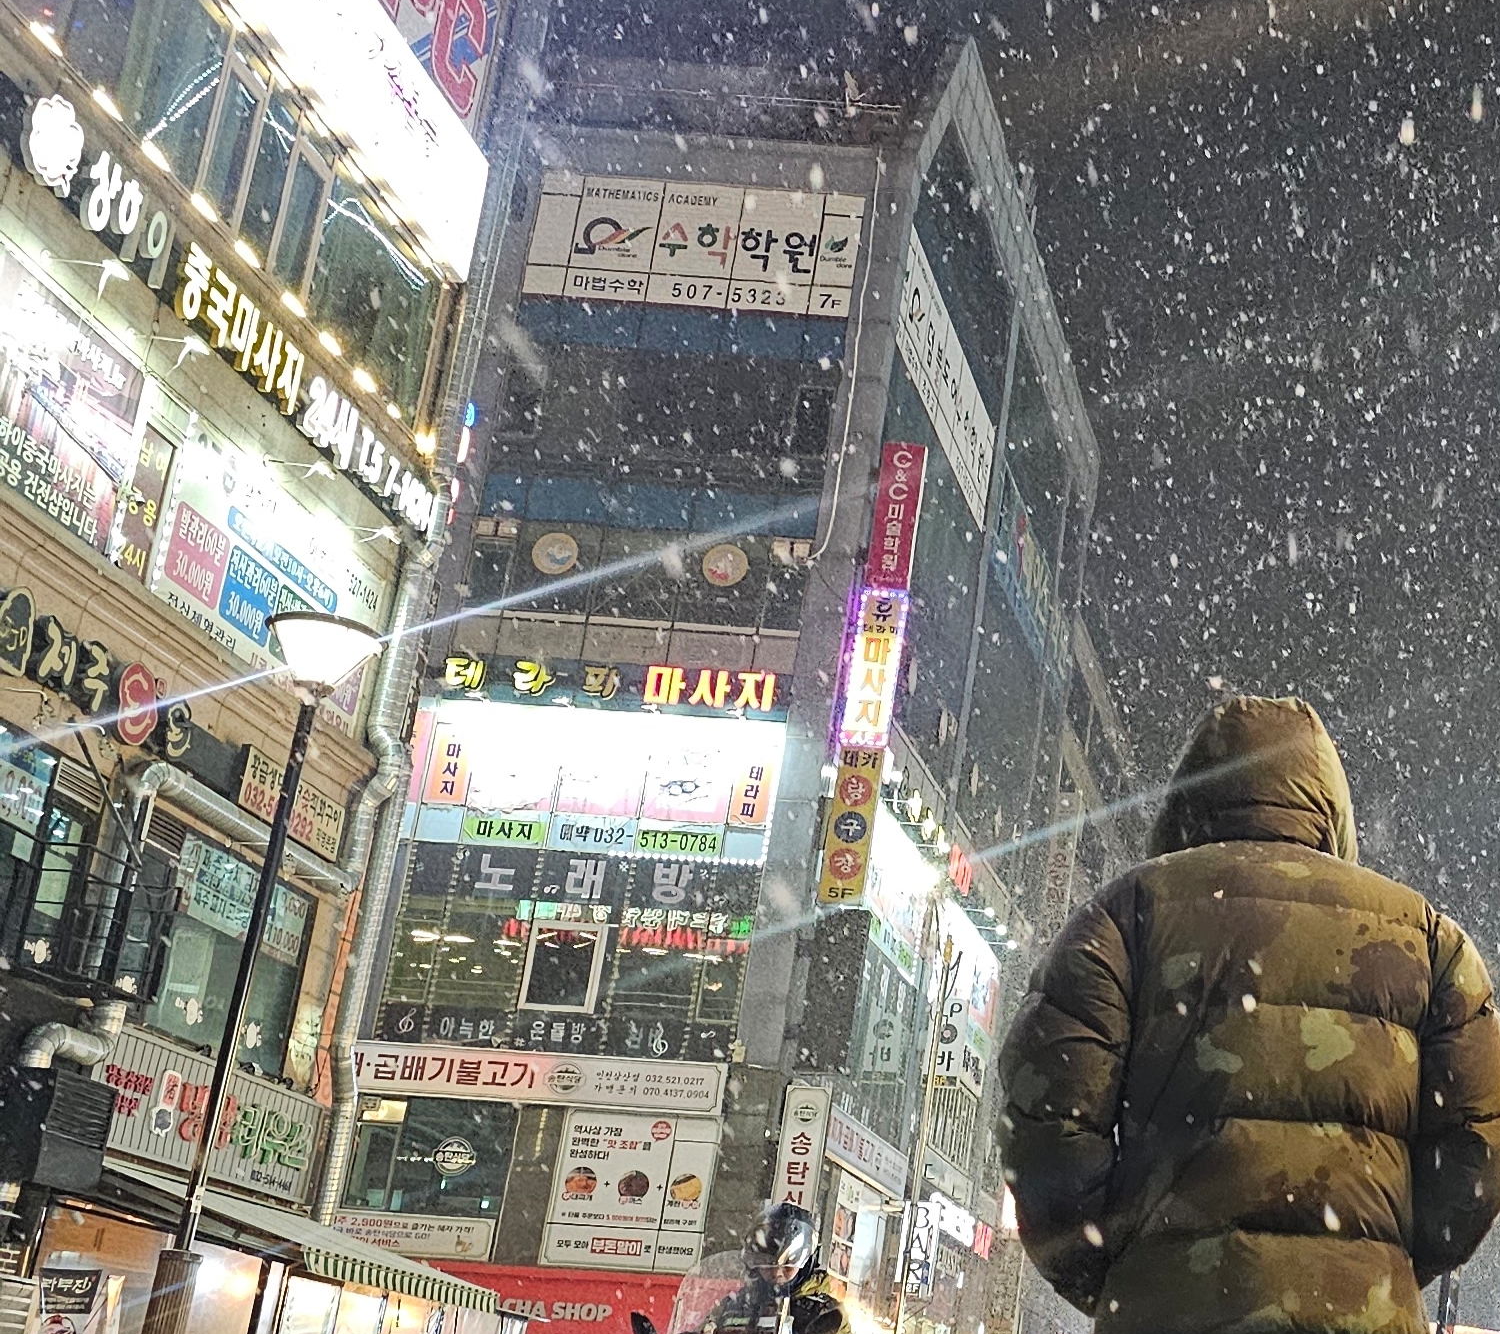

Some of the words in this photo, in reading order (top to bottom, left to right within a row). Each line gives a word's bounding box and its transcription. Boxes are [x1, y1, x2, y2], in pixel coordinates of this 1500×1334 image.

[572, 275, 645, 295] 마법수학
[818, 292, 843, 310] 7F
[175, 241, 305, 417] 중국마사지
[445, 657, 621, 701] 테라피
[643, 664, 778, 712] 마사지
[854, 636, 890, 728] 마사지
[439, 743, 462, 796] 마사지
[739, 764, 764, 819] 테라피
[475, 819, 534, 841] 마사지
[827, 886, 855, 900] 5F
[603, 1125, 623, 1137] 가장
[551, 1300, 614, 1323] SHOP
